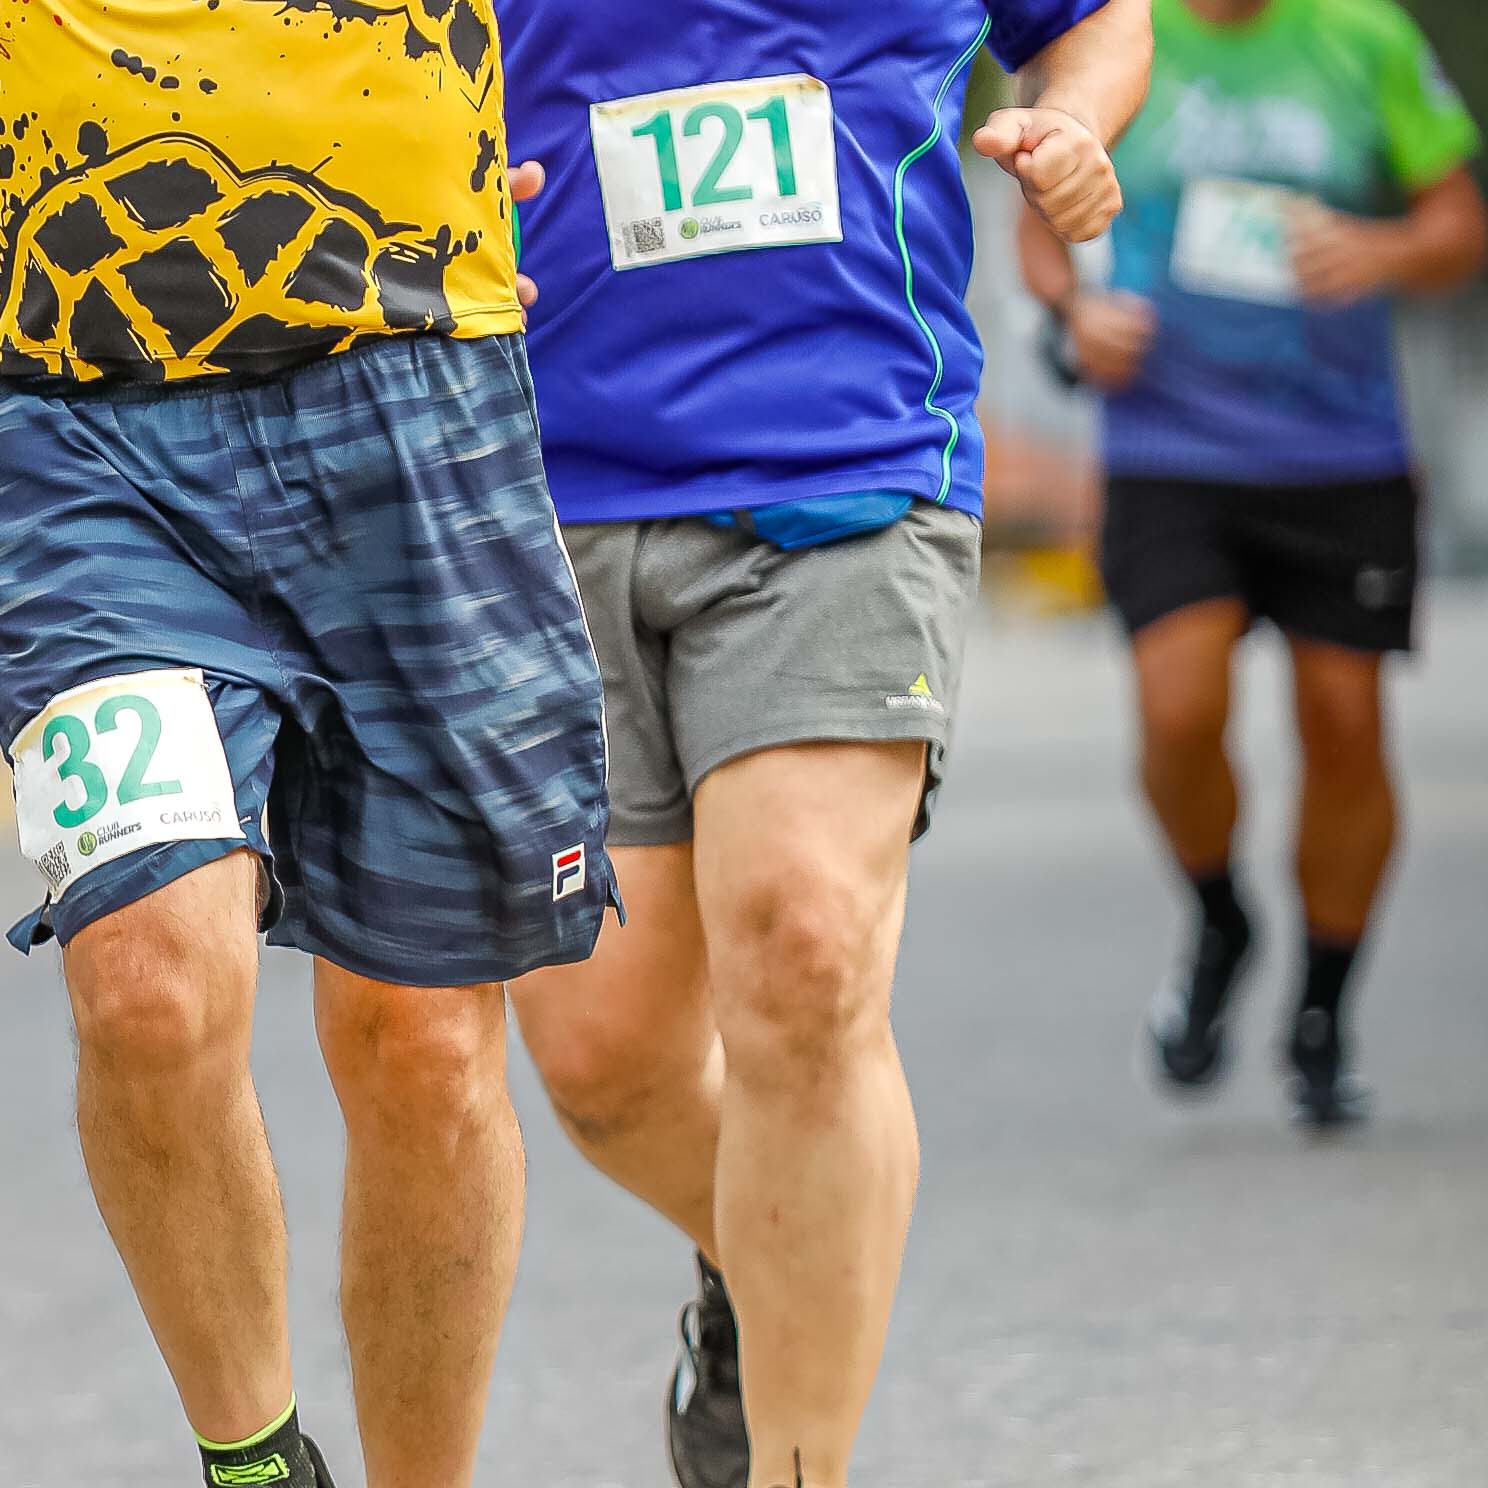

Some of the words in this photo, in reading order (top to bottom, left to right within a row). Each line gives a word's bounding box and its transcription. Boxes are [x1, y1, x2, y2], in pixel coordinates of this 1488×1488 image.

[631, 95, 797, 211] 121
[759, 209, 822, 226] CARUSO
[42, 694, 184, 828] 32
[159, 810, 221, 825] CARUSO
